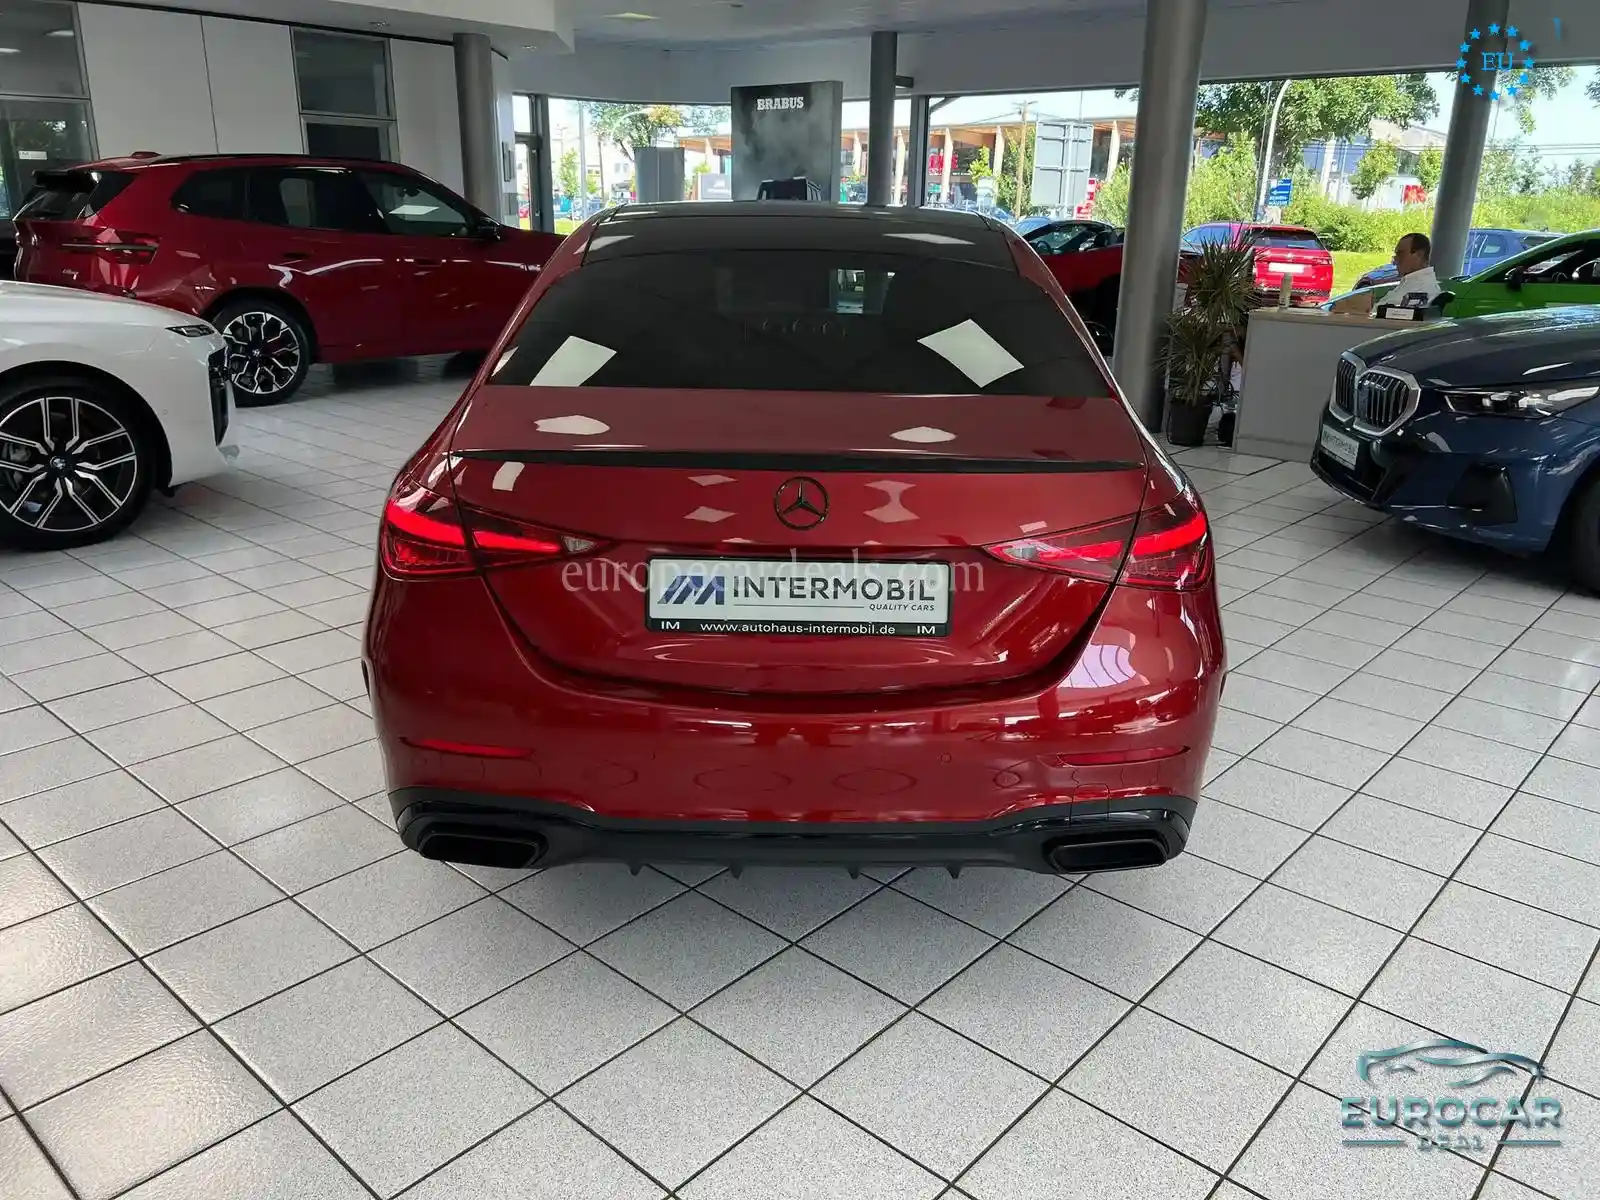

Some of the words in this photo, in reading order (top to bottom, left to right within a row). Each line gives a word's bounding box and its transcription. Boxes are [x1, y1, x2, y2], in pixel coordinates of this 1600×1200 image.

[756, 96, 804, 110] BRABUS
[733, 576, 935, 601] INTERMOBIL
[869, 603, 909, 612] QUALITY
[910, 604, 935, 612] CARS
[660, 620, 681, 630] IM
[699, 622, 896, 635] www.autohaus-intermobil.de
[917, 625, 936, 635] IM
